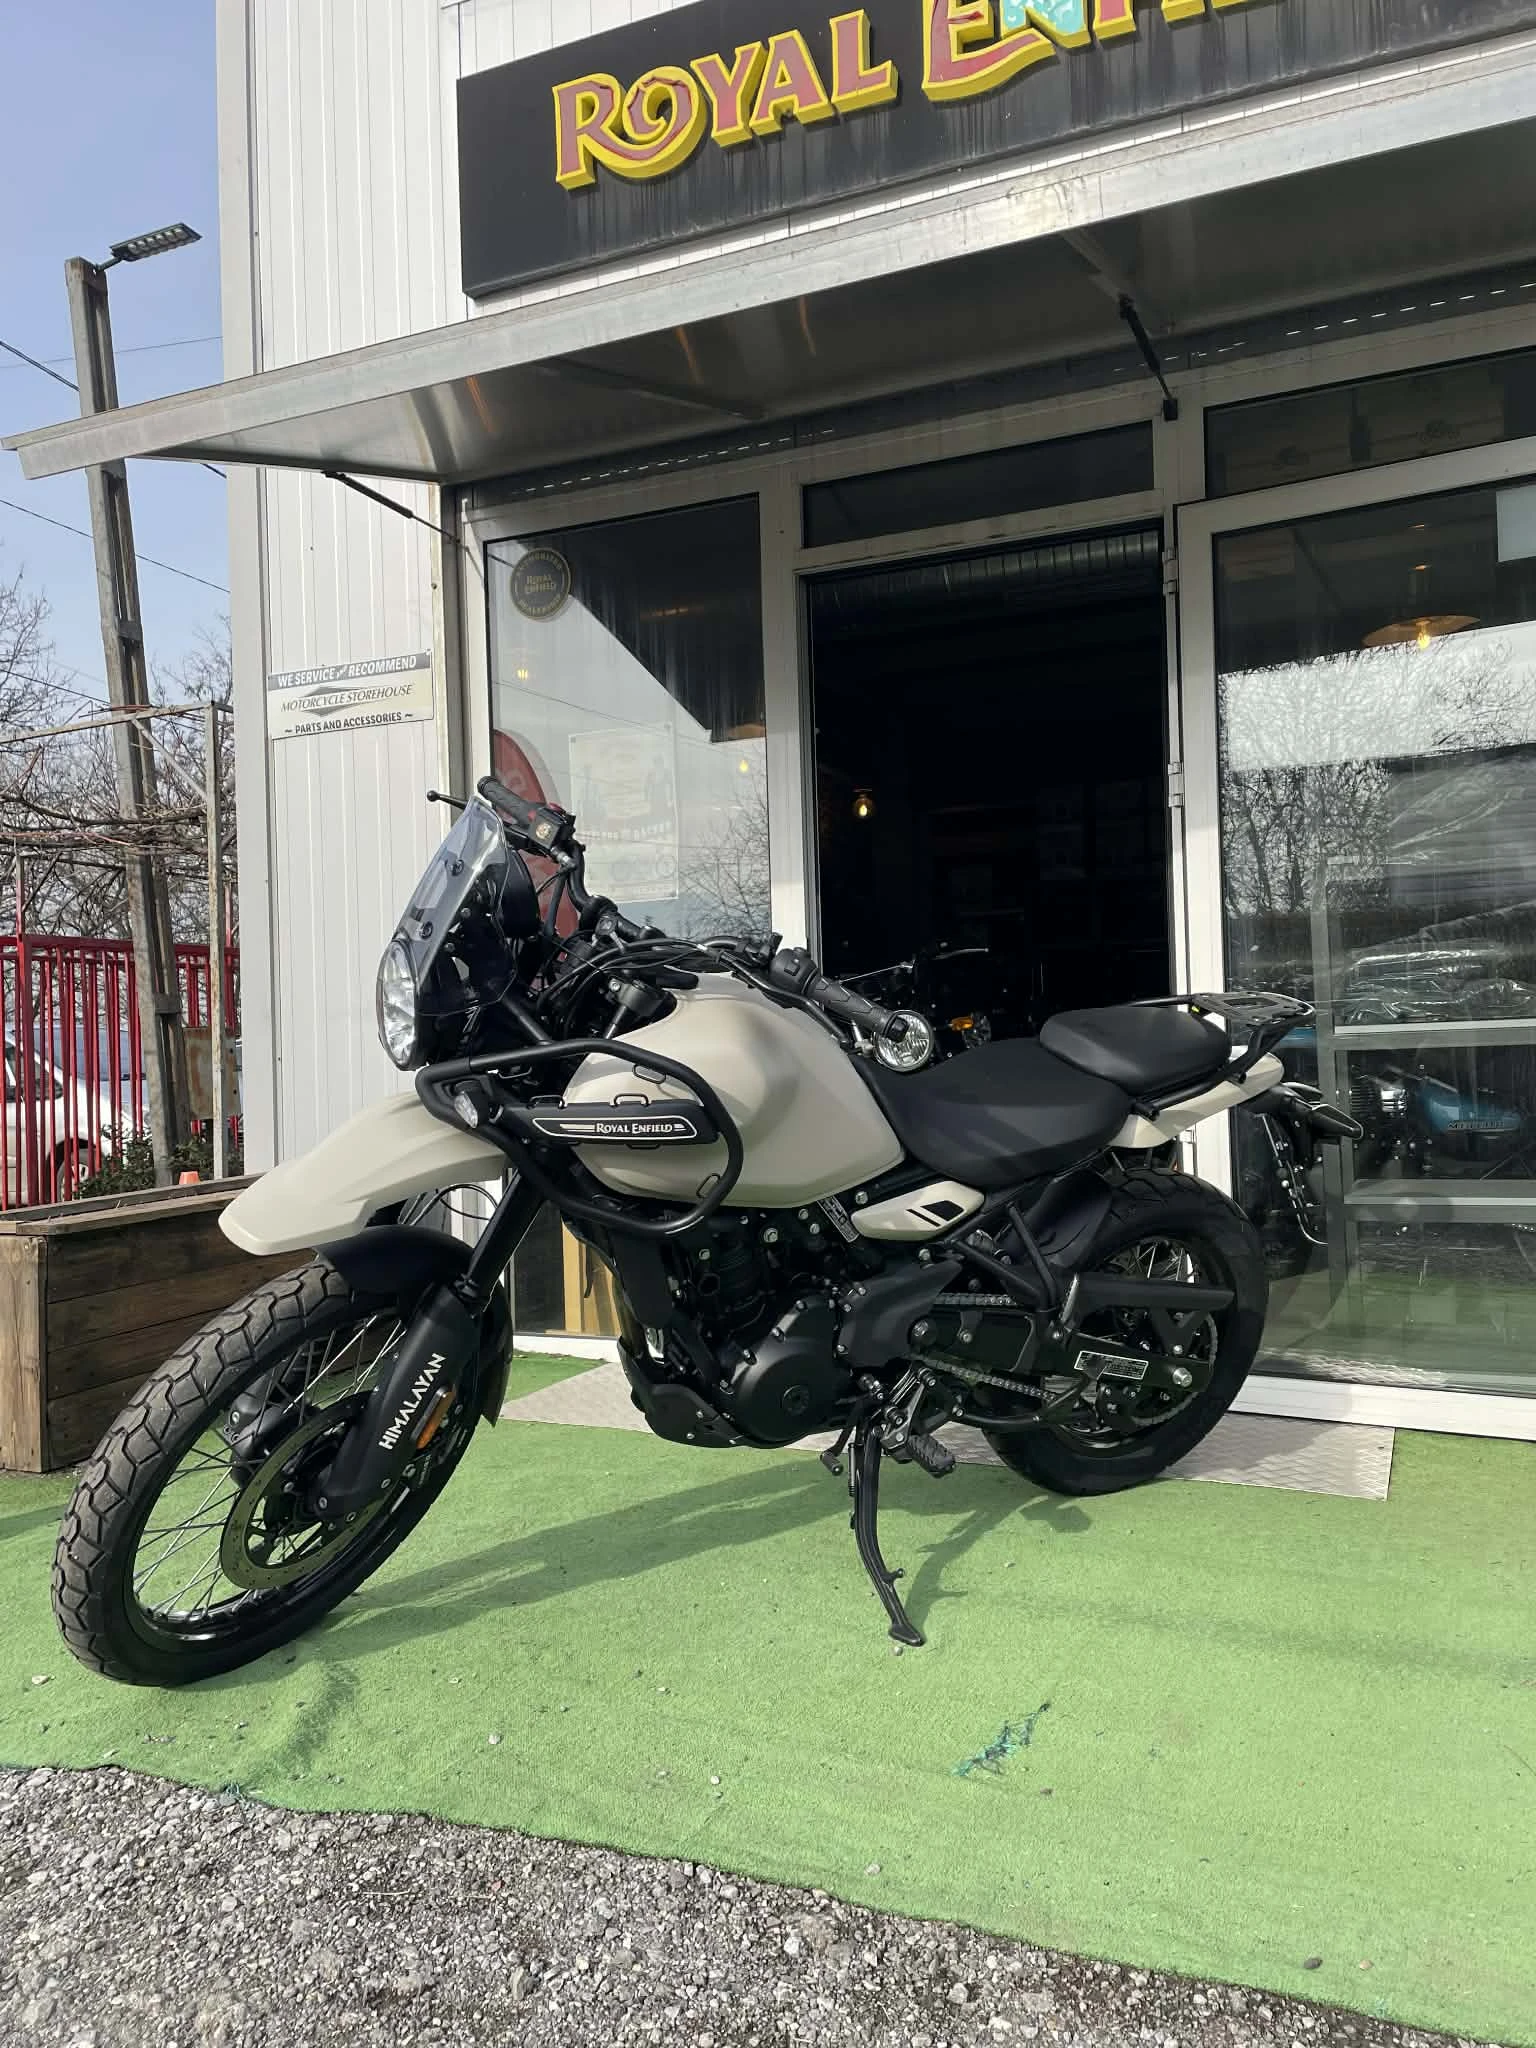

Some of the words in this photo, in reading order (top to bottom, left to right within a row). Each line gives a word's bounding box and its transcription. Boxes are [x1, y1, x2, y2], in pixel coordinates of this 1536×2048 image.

[552, 9, 898, 191] ROYAL
[278, 673, 294, 688] WE
[295, 667, 336, 686] SERVICE
[347, 655, 417, 678] RECOMMEND
[280, 692, 345, 713] MOTORCYCLE
[346, 684, 412, 702] STOREHOUSE
[295, 721, 321, 734] PARTS
[323, 719, 342, 731] AND
[343, 711, 402, 728] ACCESSORIES
[596, 1122, 630, 1134] ROYAL
[631, 1122, 673, 1134] ENFIELD
[378, 1352, 447, 1450] HIMALAYAN
